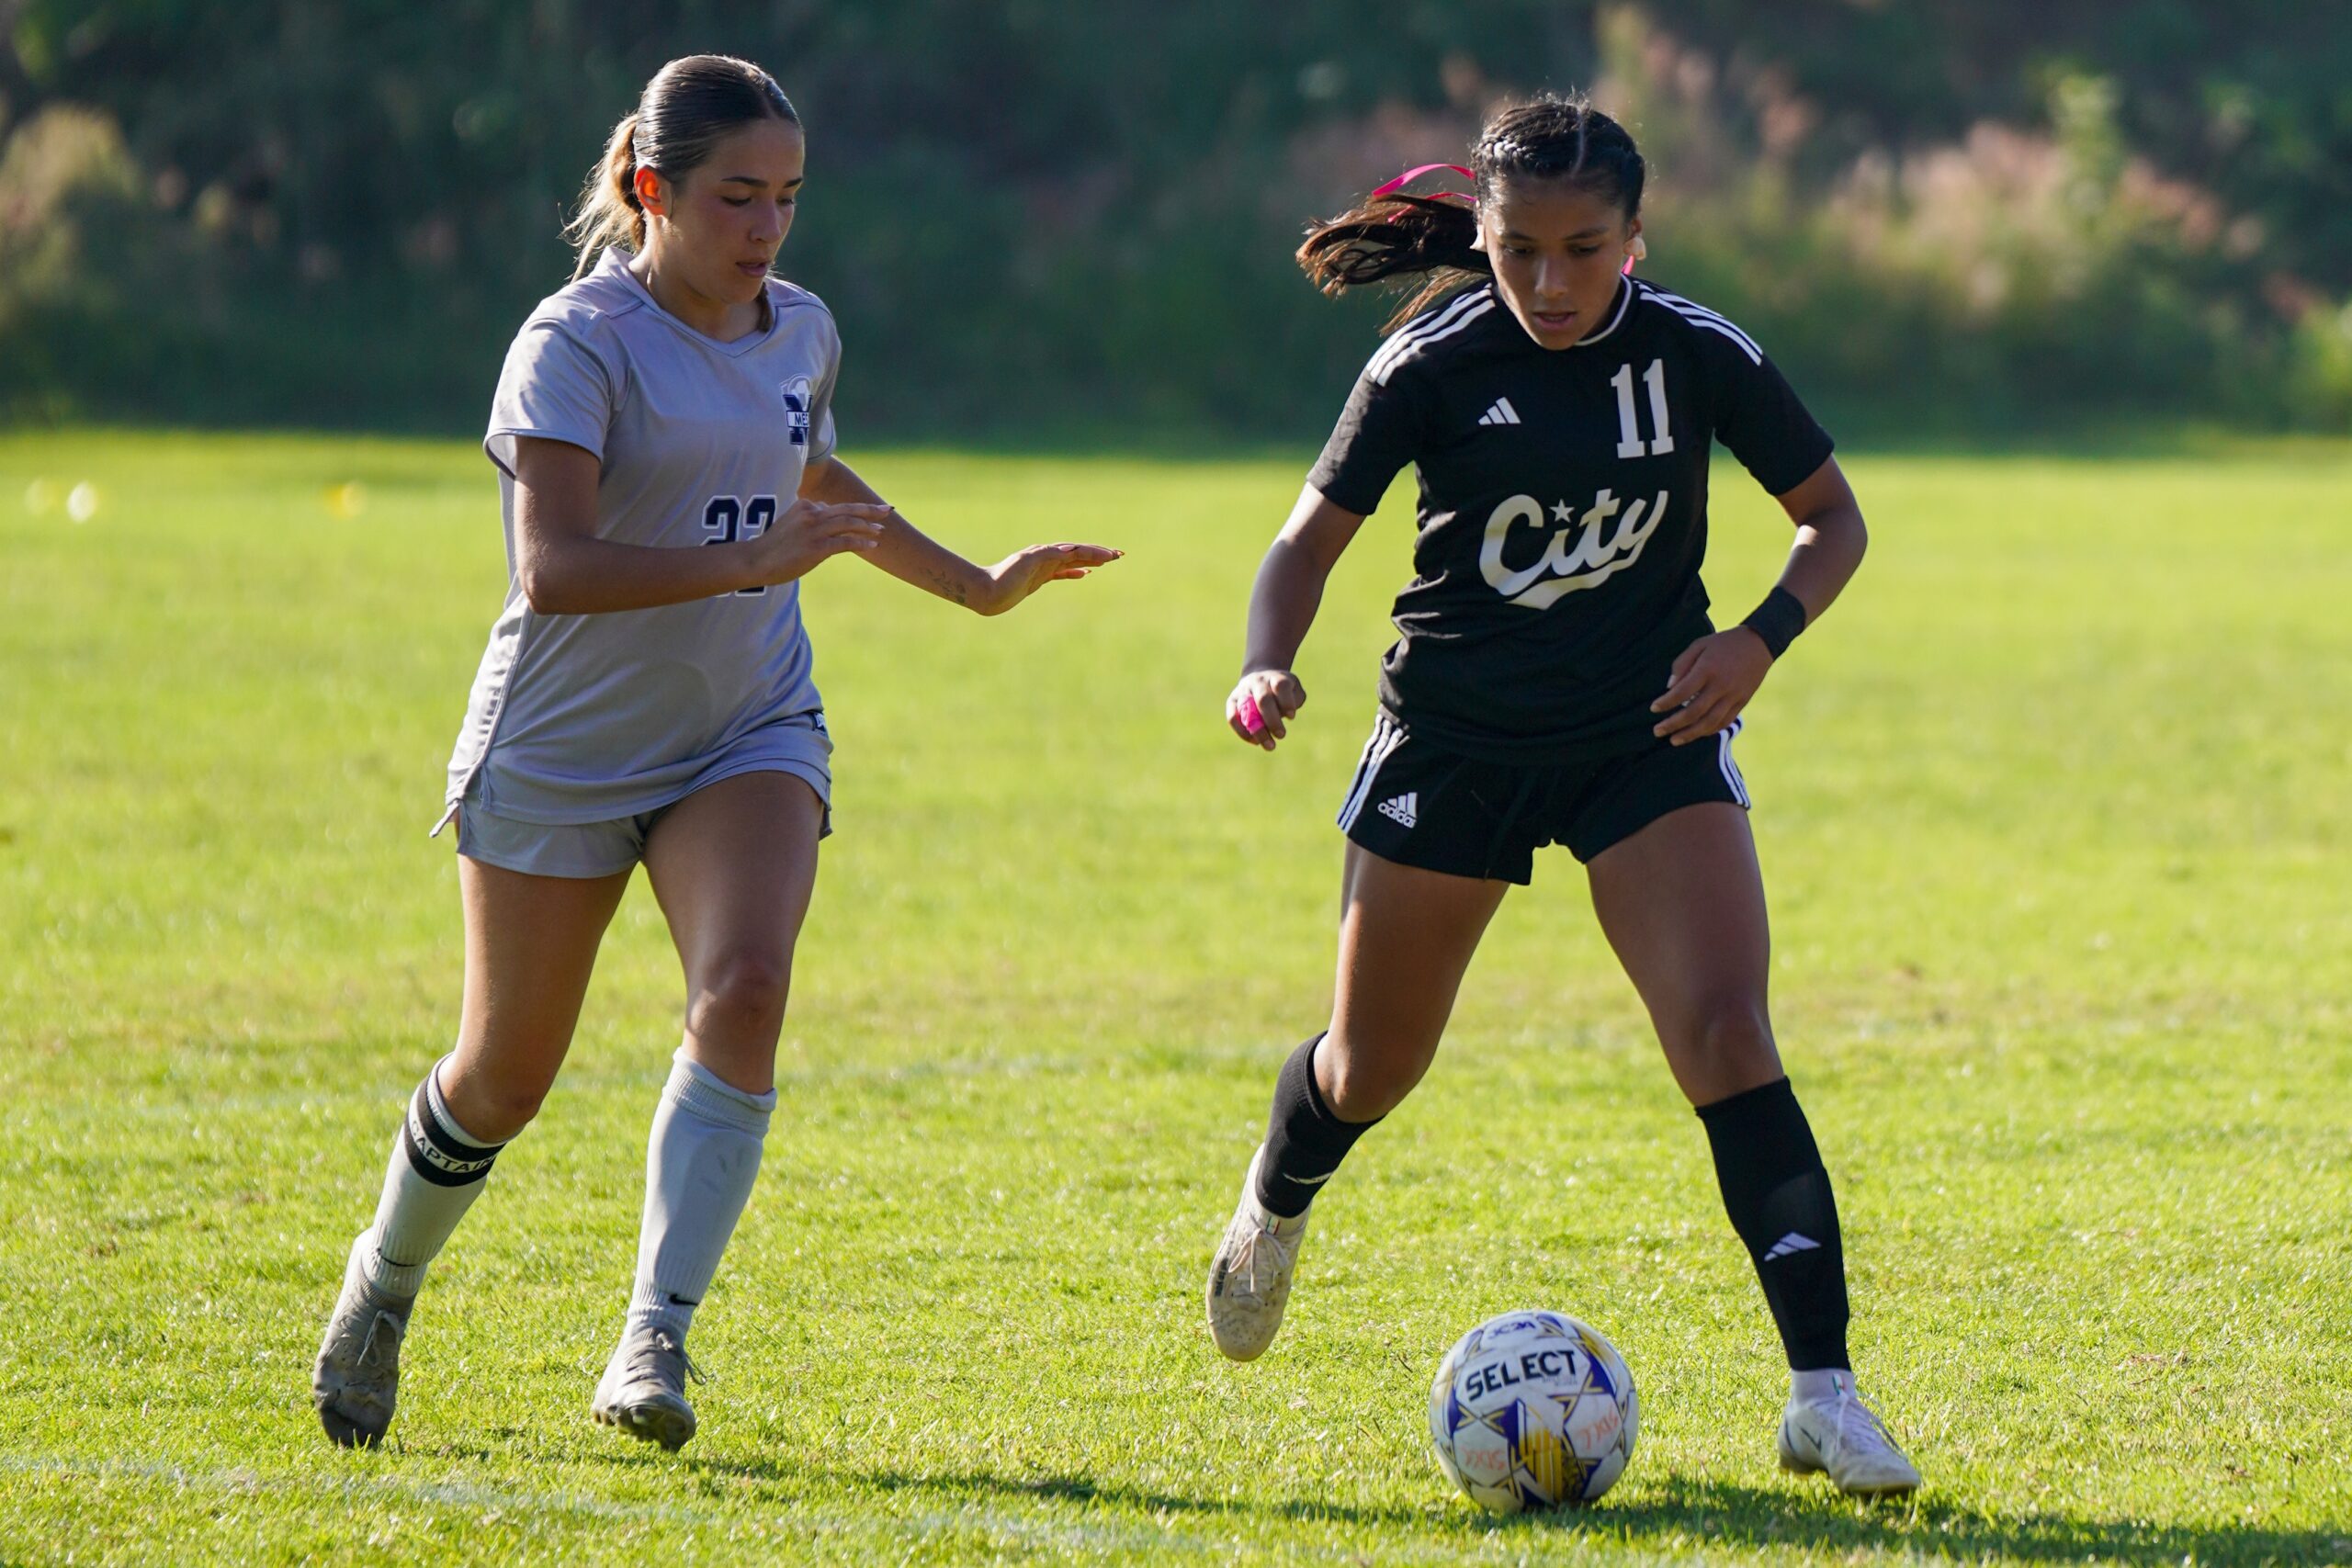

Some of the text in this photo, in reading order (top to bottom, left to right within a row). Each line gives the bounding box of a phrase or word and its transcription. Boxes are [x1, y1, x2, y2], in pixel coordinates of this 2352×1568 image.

[1611, 358, 1674, 458] 11
[1479, 489, 1668, 610] City
[1465, 1350, 1576, 1403] SELECT
